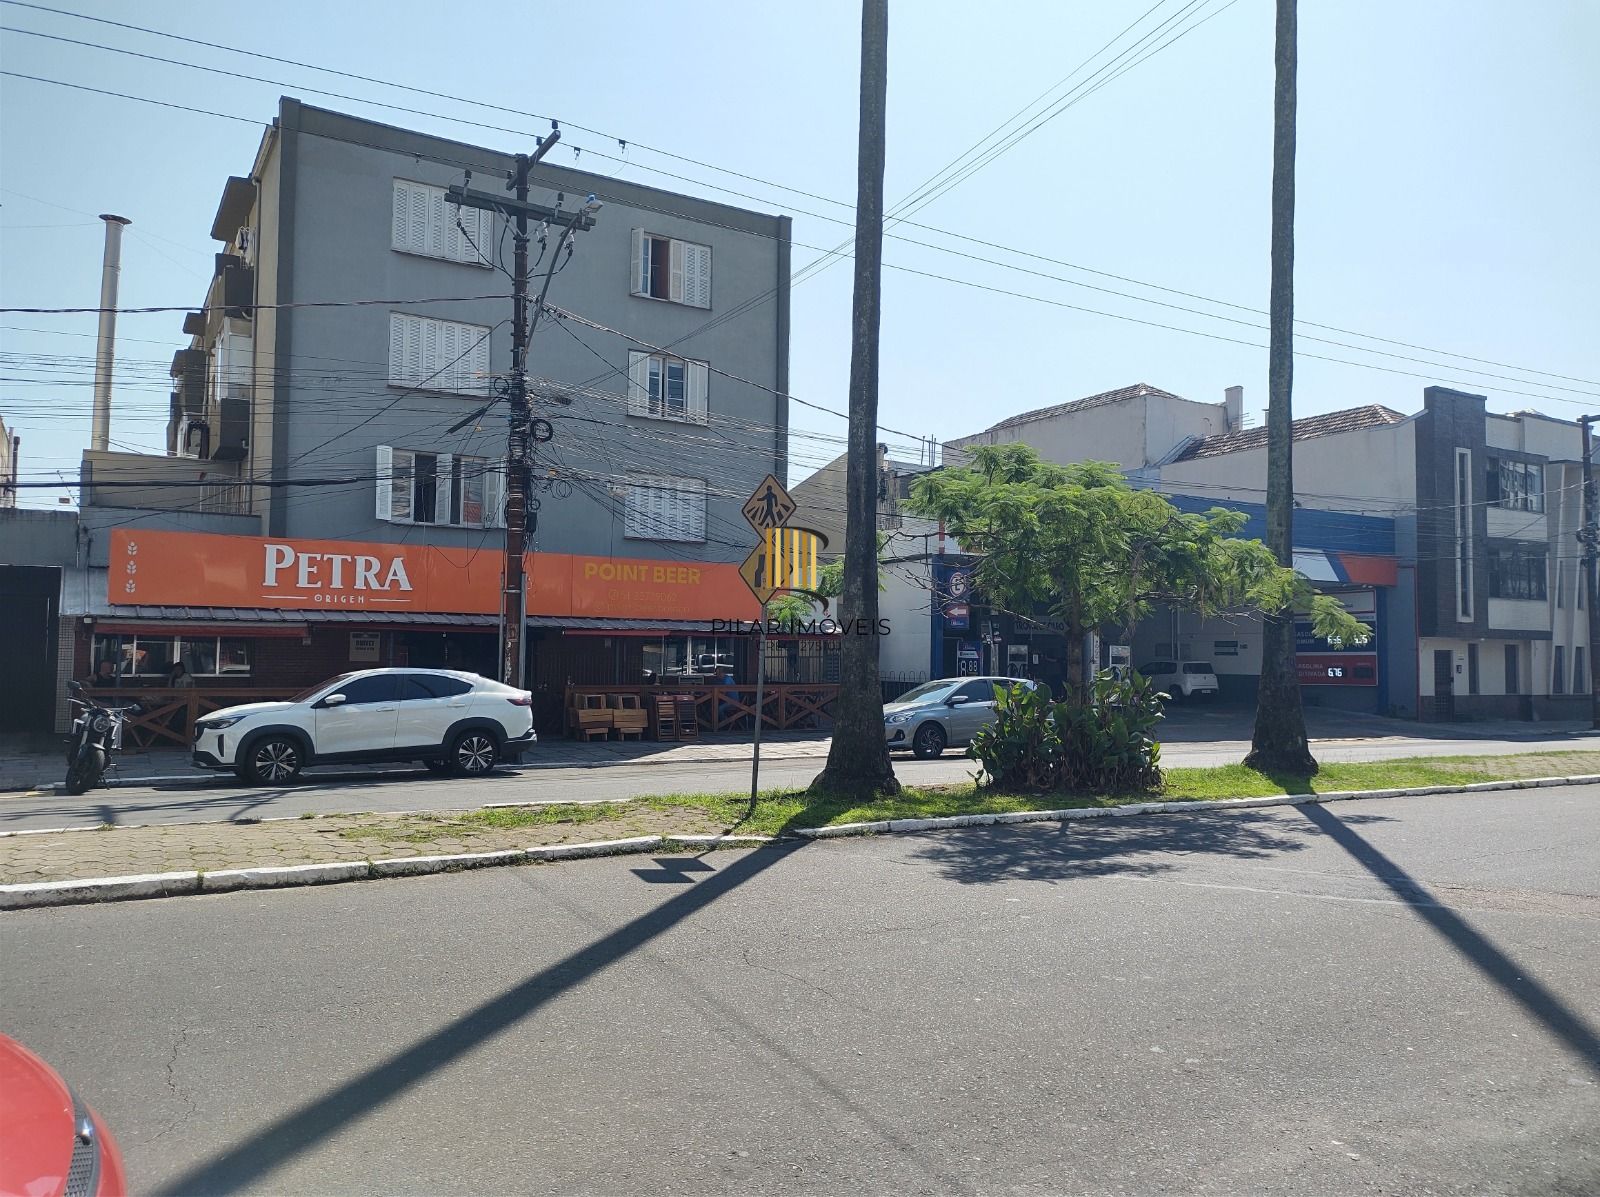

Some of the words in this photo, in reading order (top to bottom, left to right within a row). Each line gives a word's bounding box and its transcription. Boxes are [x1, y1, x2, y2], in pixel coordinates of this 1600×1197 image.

[262, 543, 413, 591] PETRA
[584, 562, 648, 582] POINT
[653, 566, 701, 585] BEER
